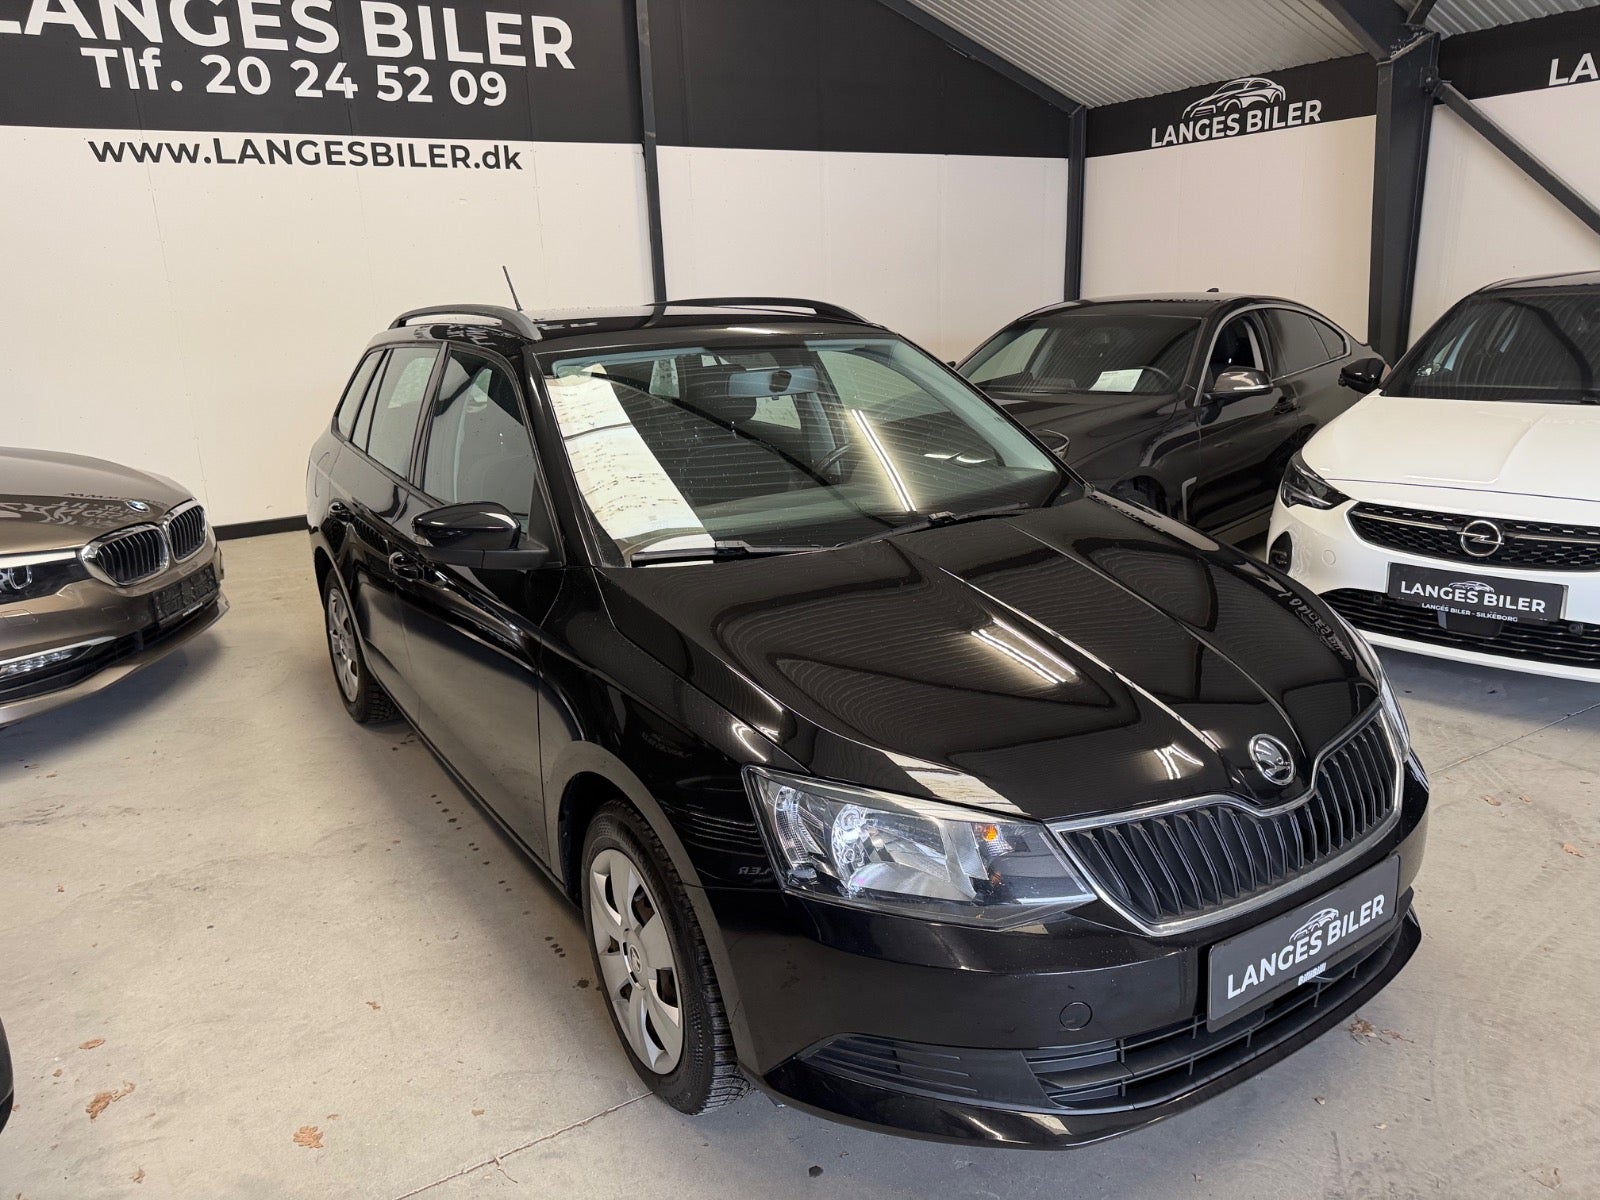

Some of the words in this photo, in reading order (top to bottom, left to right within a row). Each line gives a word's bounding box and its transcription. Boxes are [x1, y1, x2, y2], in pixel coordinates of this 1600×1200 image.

[360, 0, 576, 70] BILER
[79, 47, 184, 92] Tlf.
[200, 54, 272, 96] 20
[290, 59, 359, 99] 24
[376, 64, 433, 103] 52
[449, 69, 507, 107] 09
[1150, 114, 1240, 148] LANGES
[1246, 99, 1323, 133] BILER
[88, 137, 524, 170] www.LANGESBILER.dk
[1400, 580, 1480, 604] LANGES
[1483, 593, 1546, 614] BILER
[1227, 930, 1323, 1000] LANGES
[1326, 894, 1385, 946] BILER
